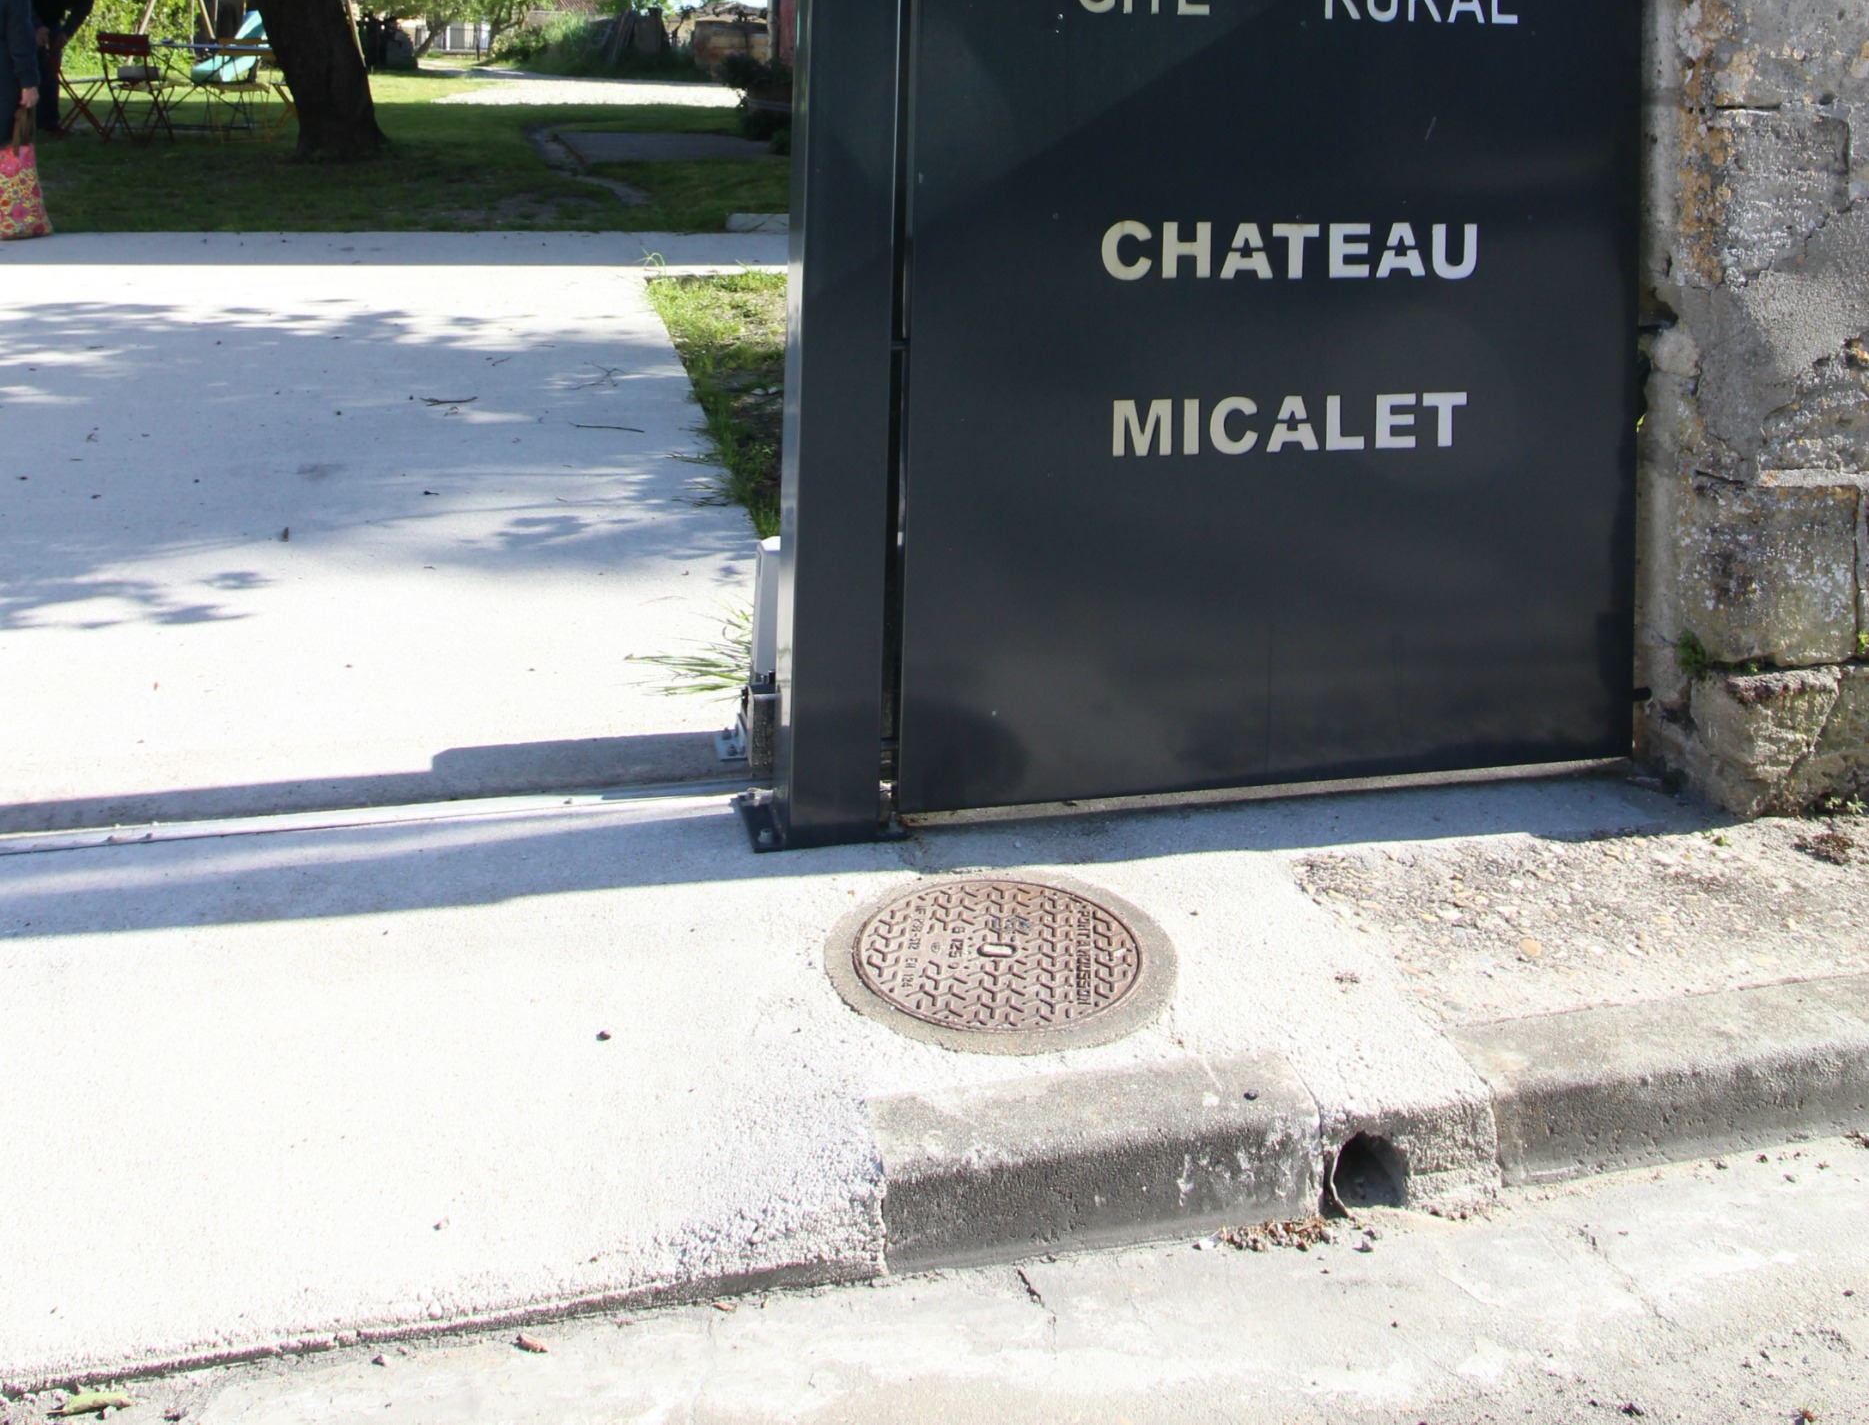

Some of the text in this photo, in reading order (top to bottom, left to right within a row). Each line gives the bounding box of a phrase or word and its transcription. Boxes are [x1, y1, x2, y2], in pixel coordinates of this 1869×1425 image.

[1101, 219, 1479, 281] CHATEAU
[1112, 390, 1469, 458] MICALET
[948, 938, 964, 958] 125
